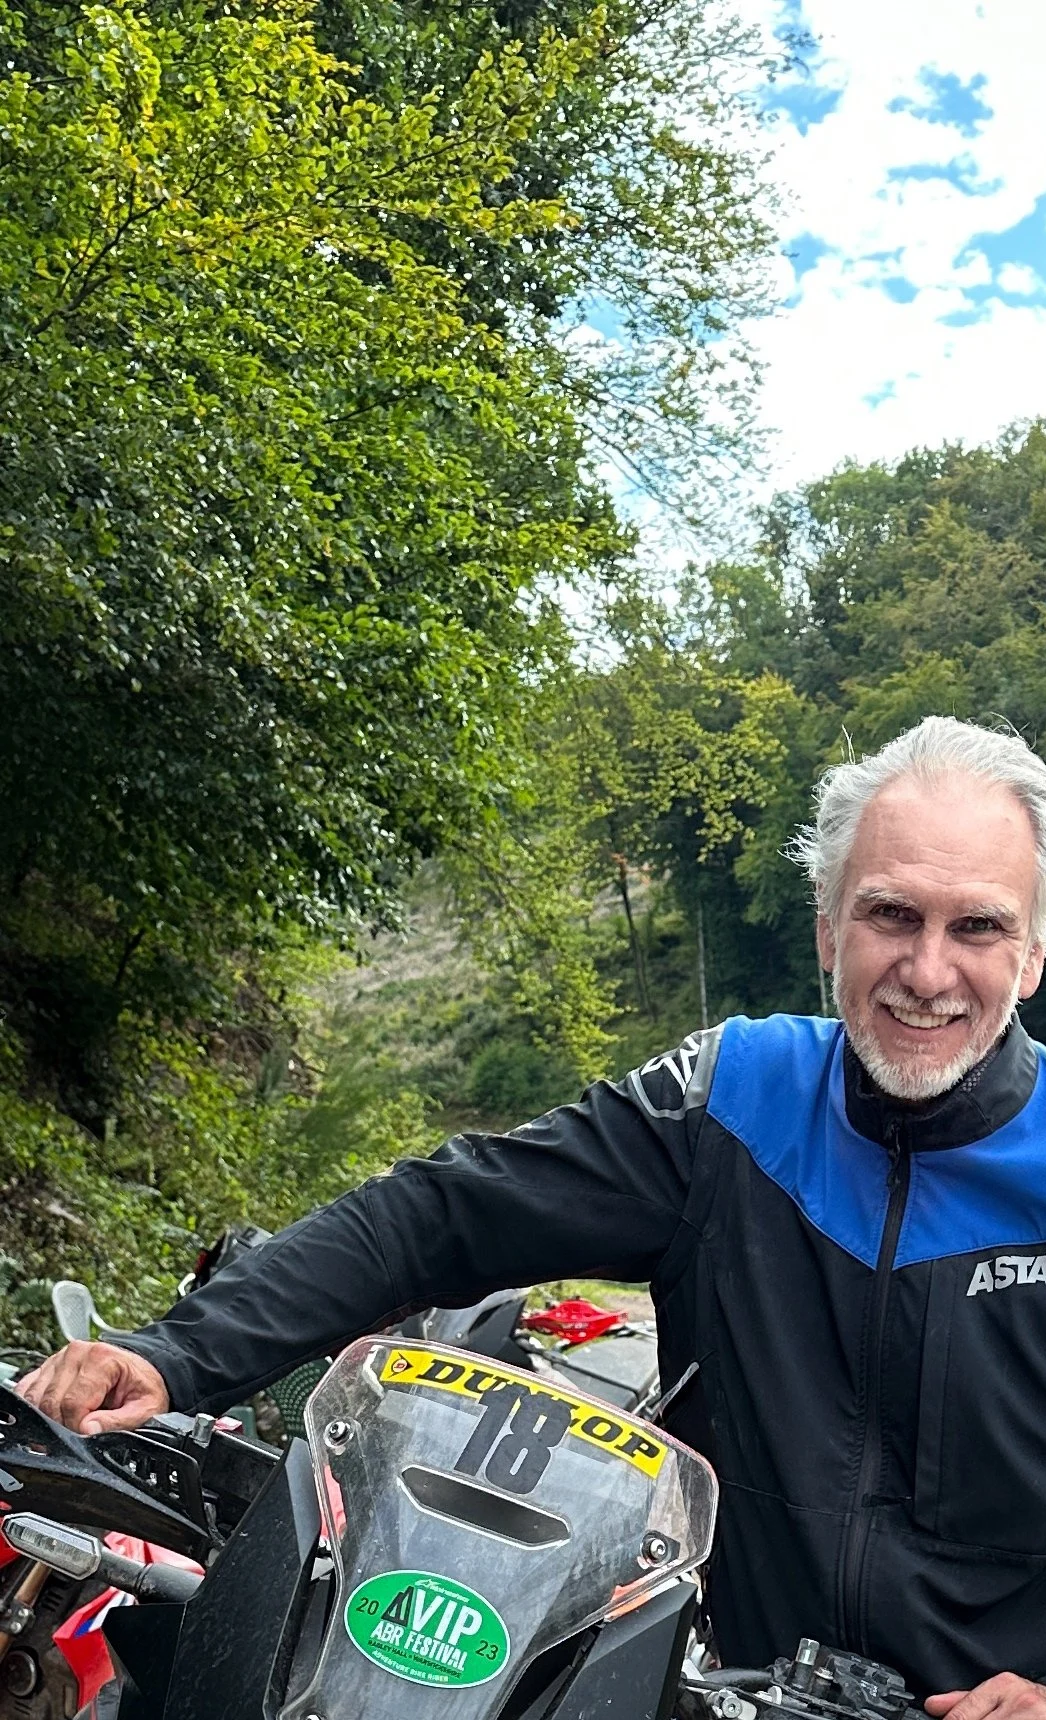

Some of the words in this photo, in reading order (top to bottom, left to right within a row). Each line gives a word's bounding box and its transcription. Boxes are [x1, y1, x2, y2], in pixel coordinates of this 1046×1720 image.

[416, 1358, 660, 1459] DUOP
[454, 1384, 572, 1495] 18
[356, 1597, 379, 1616] 20
[412, 1588, 483, 1646] VIP
[370, 1620, 404, 1647] ABR
[404, 1630, 468, 1672] FESTIVAL
[475, 1640, 499, 1661] 23
